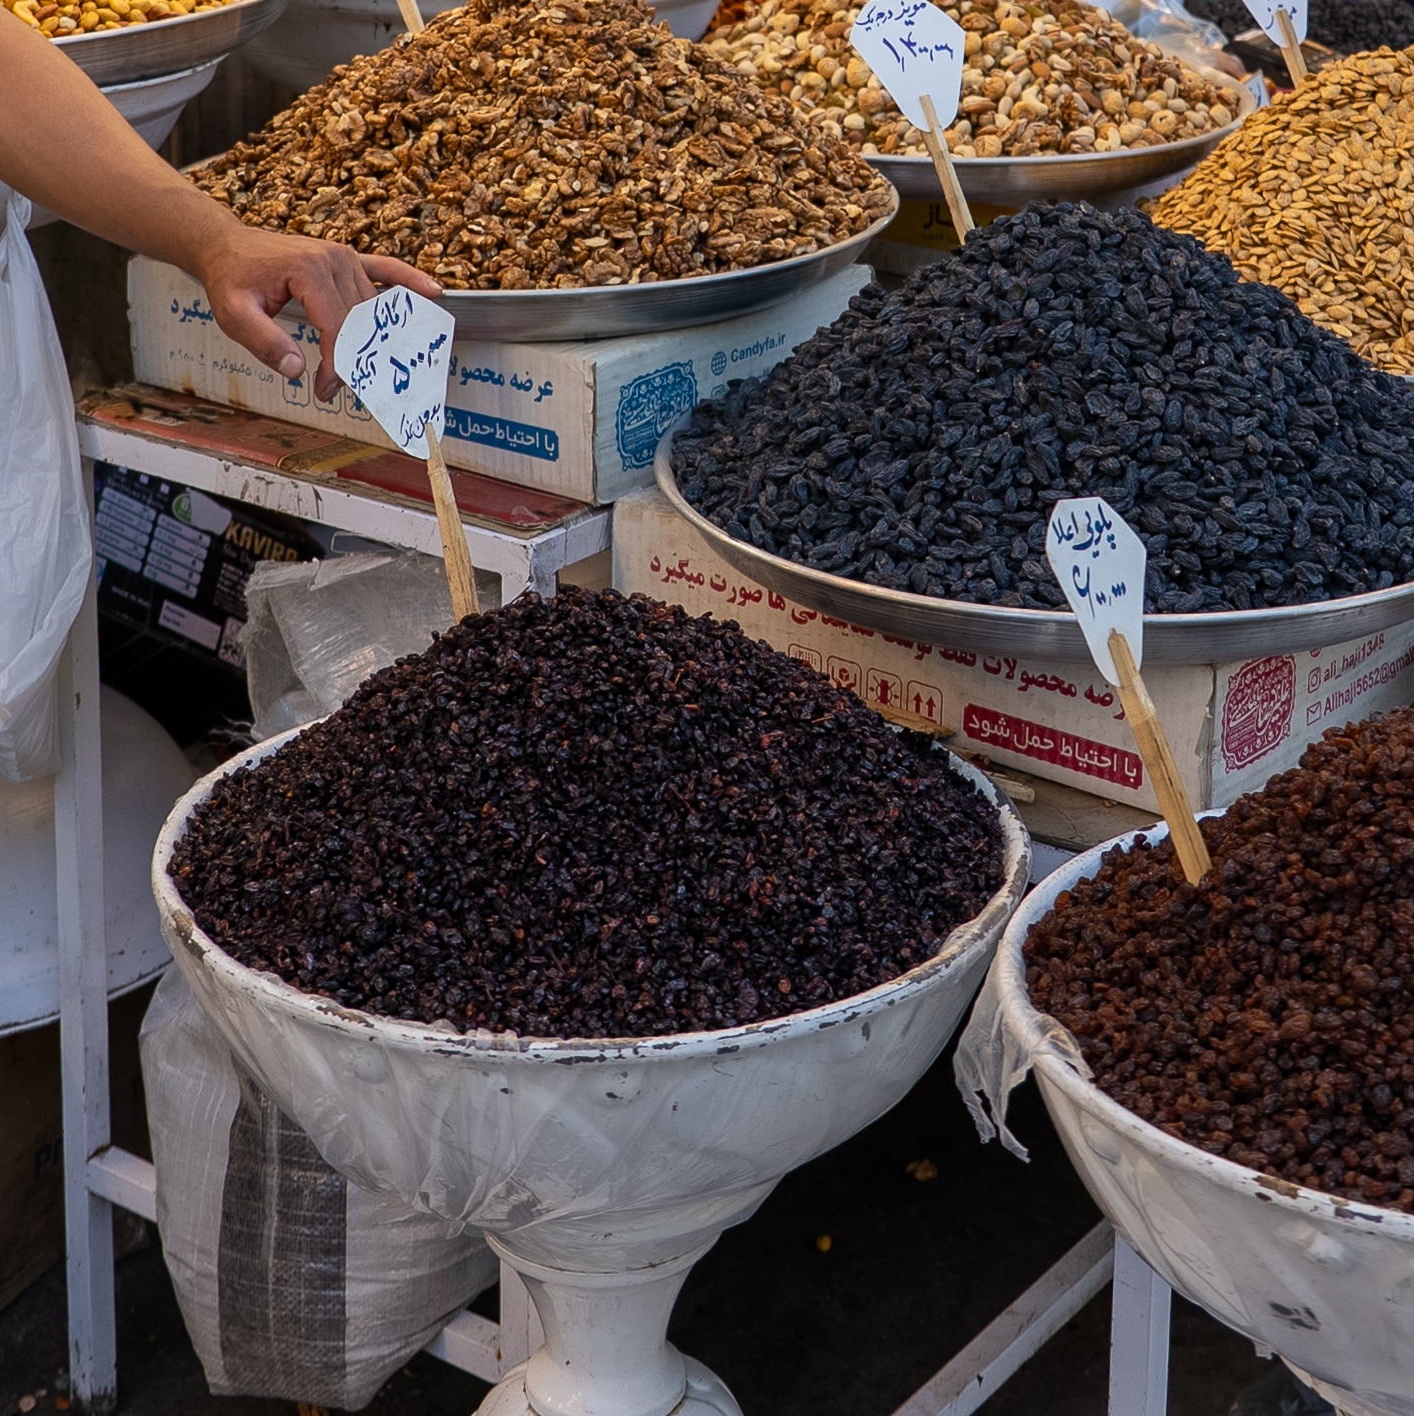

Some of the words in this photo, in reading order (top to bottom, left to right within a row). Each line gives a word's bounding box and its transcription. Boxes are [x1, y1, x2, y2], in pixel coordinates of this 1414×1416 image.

[731, 333, 786, 363] Candyfa.ir
[449, 356, 506, 388] محصولا
[510, 376, 554, 403] عرضه
[458, 416, 491, 438] حمل
[494, 425, 540, 448] احتیاط
[544, 433, 555, 451] با
[650, 554, 704, 588] میگیرد
[709, 576, 762, 607] صورت
[967, 714, 1010, 740] شود
[1013, 729, 1056, 752] حمل
[1063, 742, 1118, 772] احتیاط
[1123, 754, 1136, 777] با
